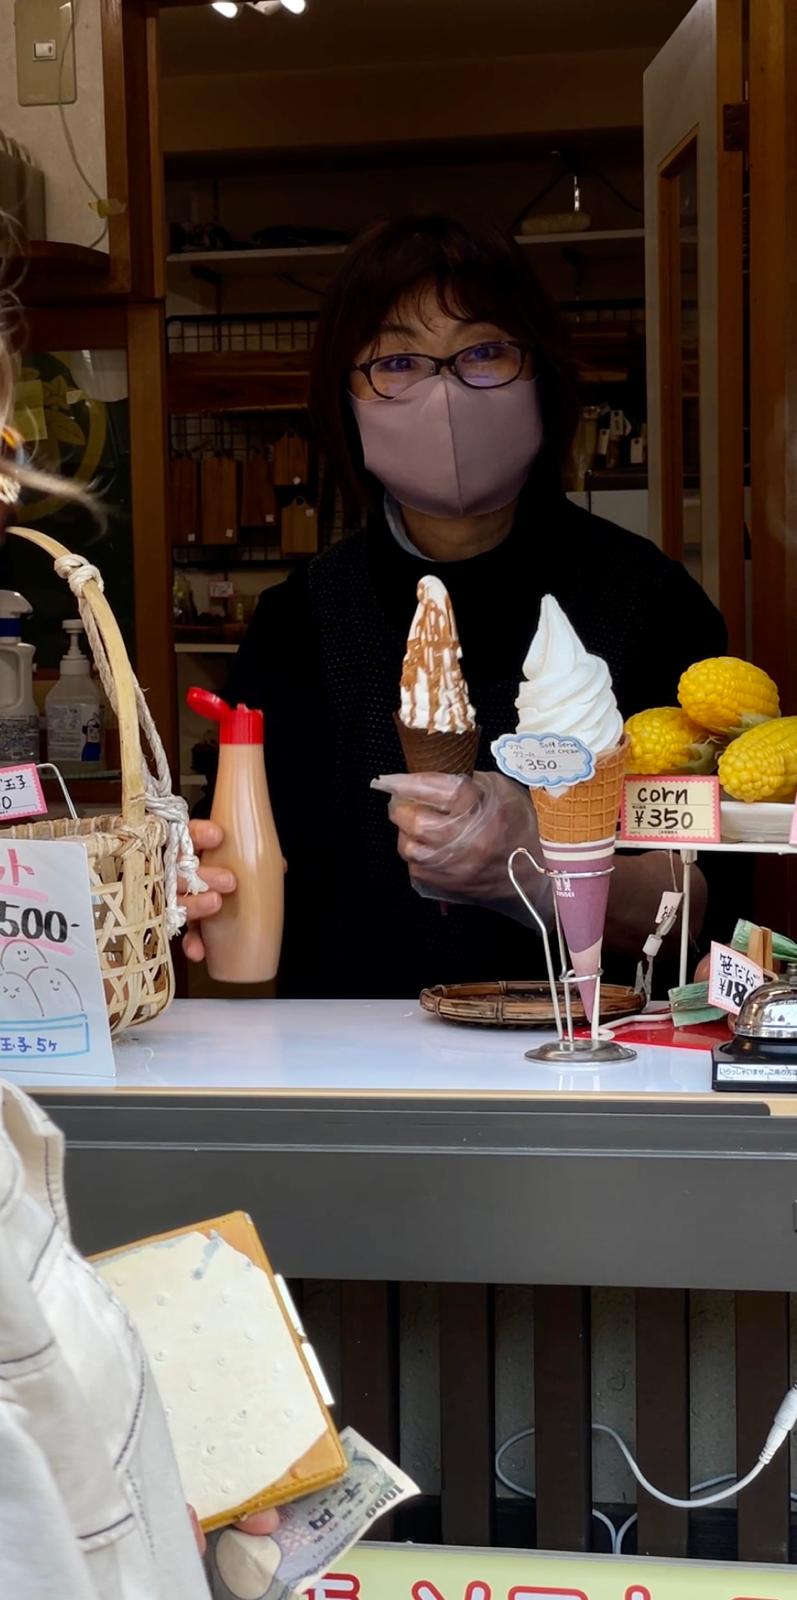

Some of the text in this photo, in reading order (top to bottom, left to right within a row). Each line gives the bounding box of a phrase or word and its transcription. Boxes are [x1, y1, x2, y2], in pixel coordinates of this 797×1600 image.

[0, 774, 26, 791] 玉子
[637, 787, 688, 805] corn
[633, 807, 694, 830] ¥350
[364, 1483, 406, 1520] 1000
